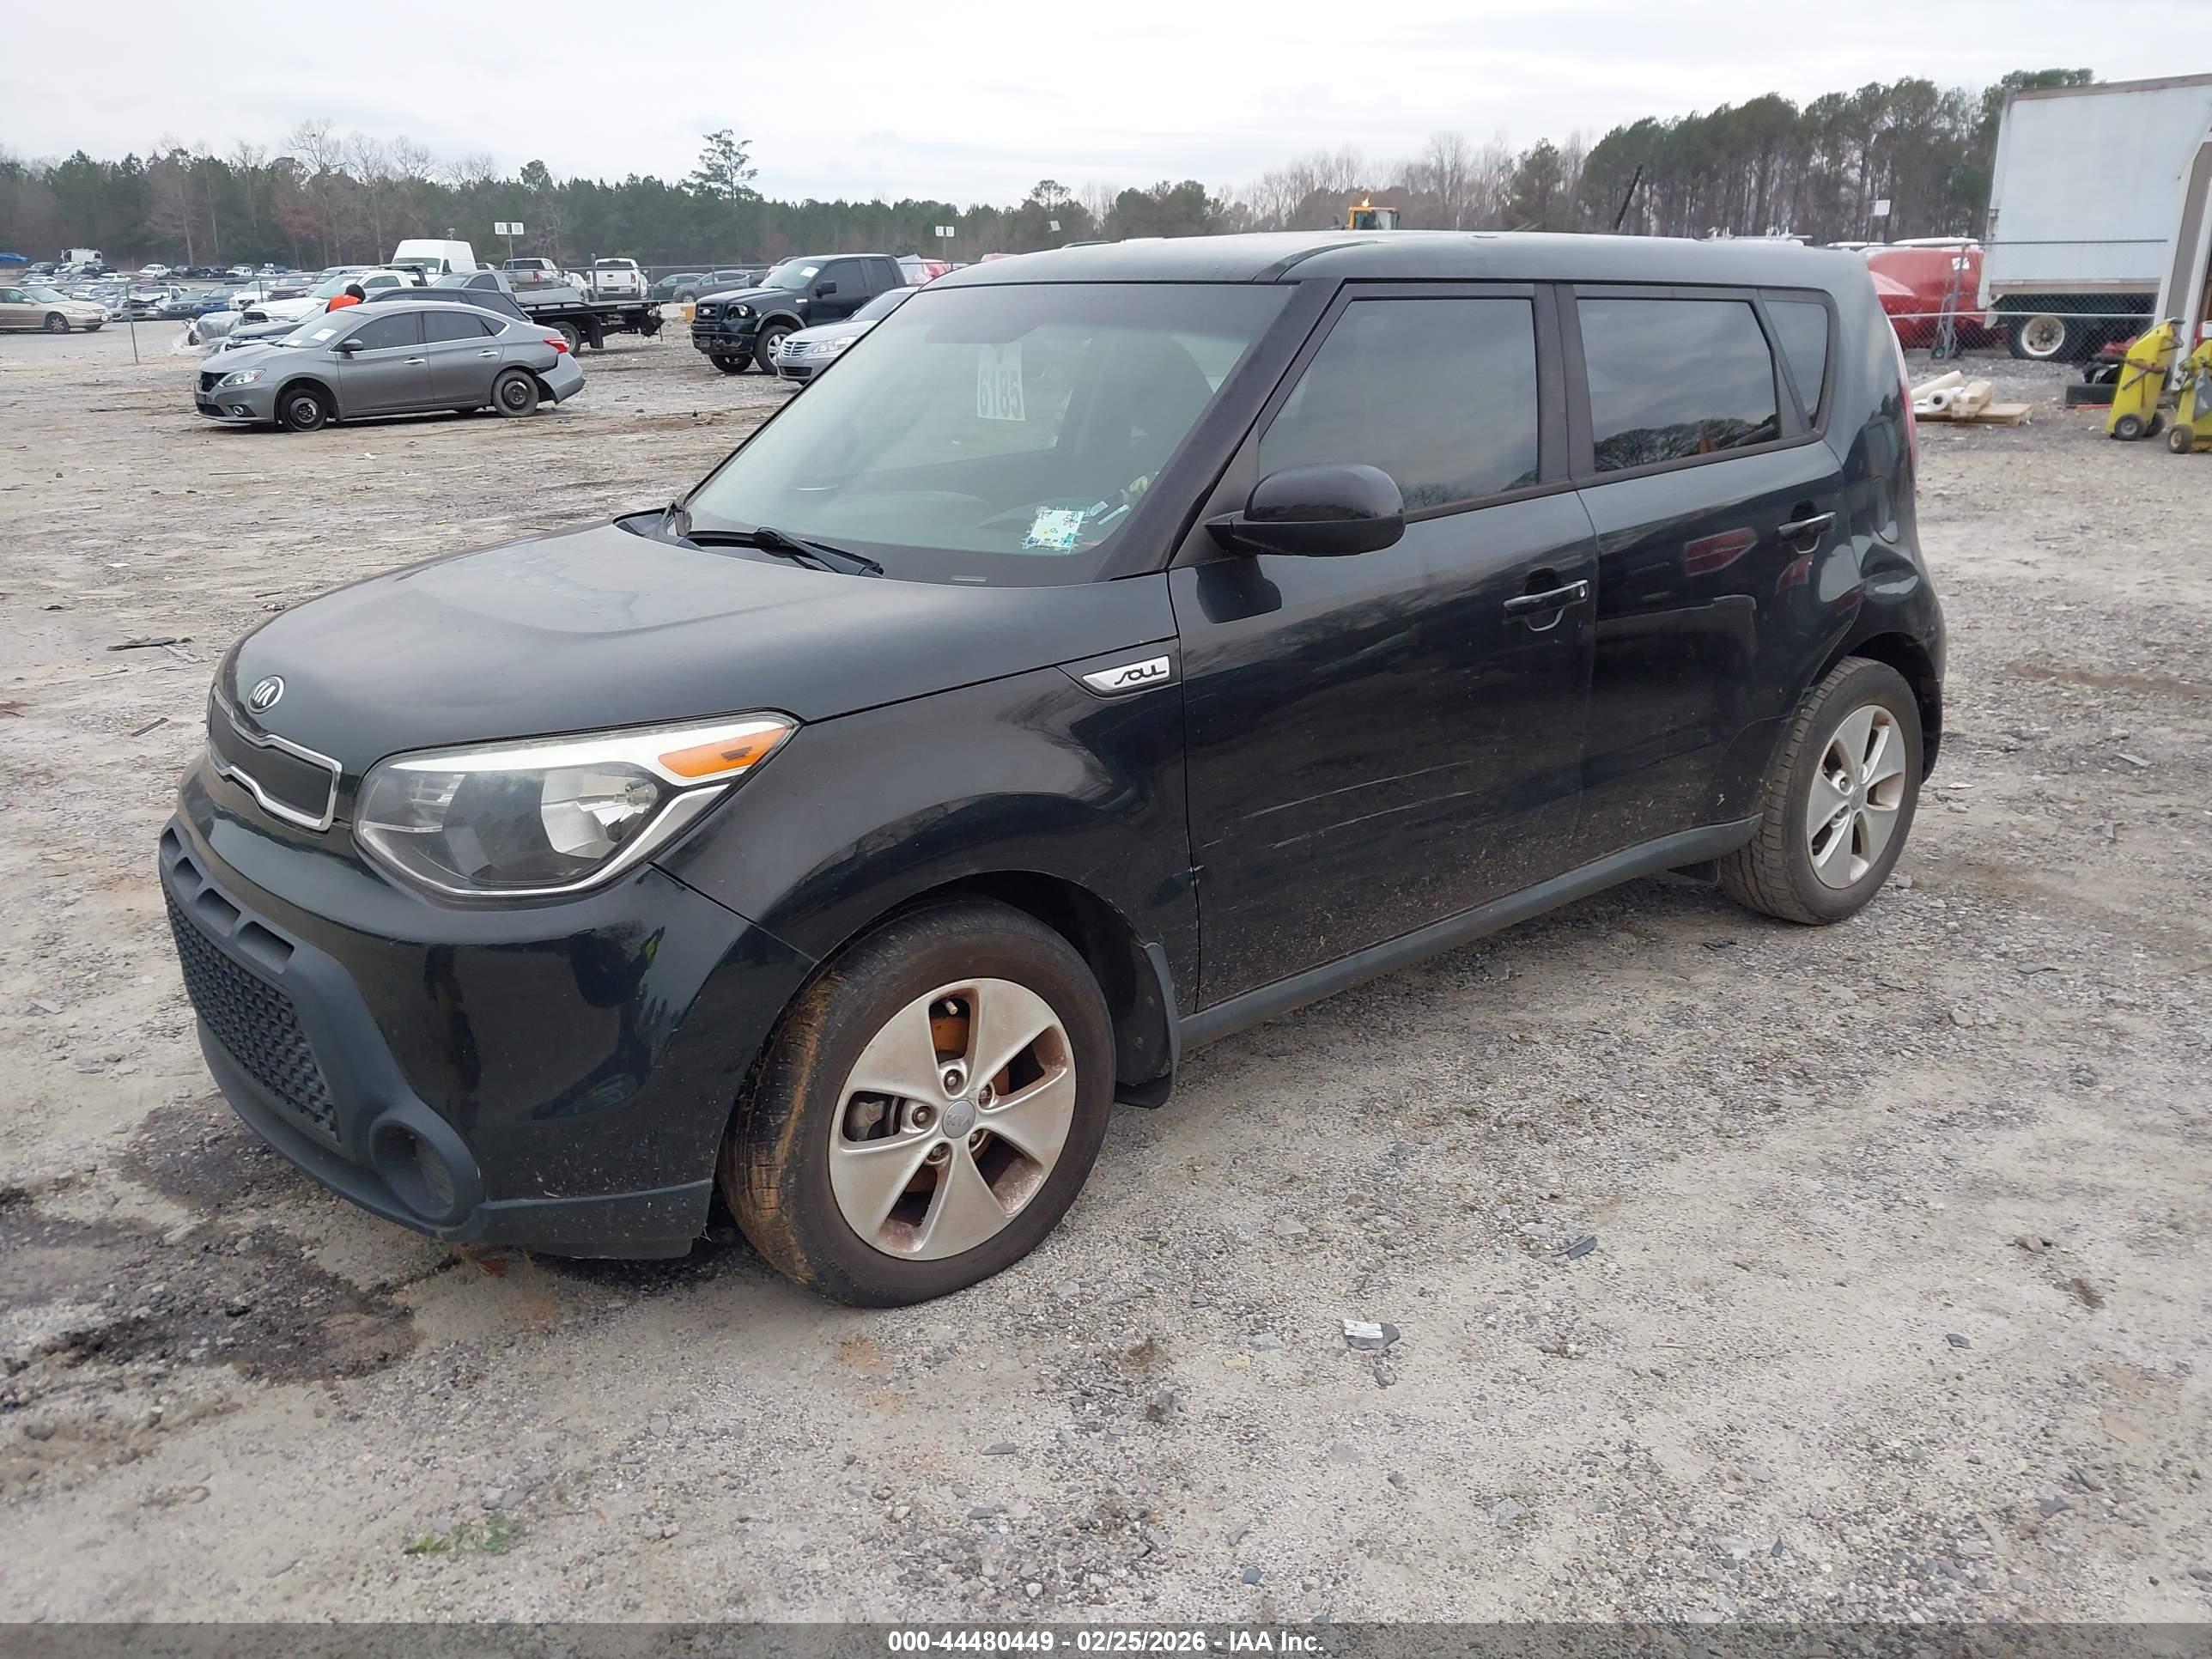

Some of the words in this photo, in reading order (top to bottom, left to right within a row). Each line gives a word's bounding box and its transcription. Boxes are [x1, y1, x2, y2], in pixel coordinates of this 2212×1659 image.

[979, 368, 1021, 420] 6185
[1114, 664, 1167, 686] SOUL
[947, 1113, 973, 1127] KIA
